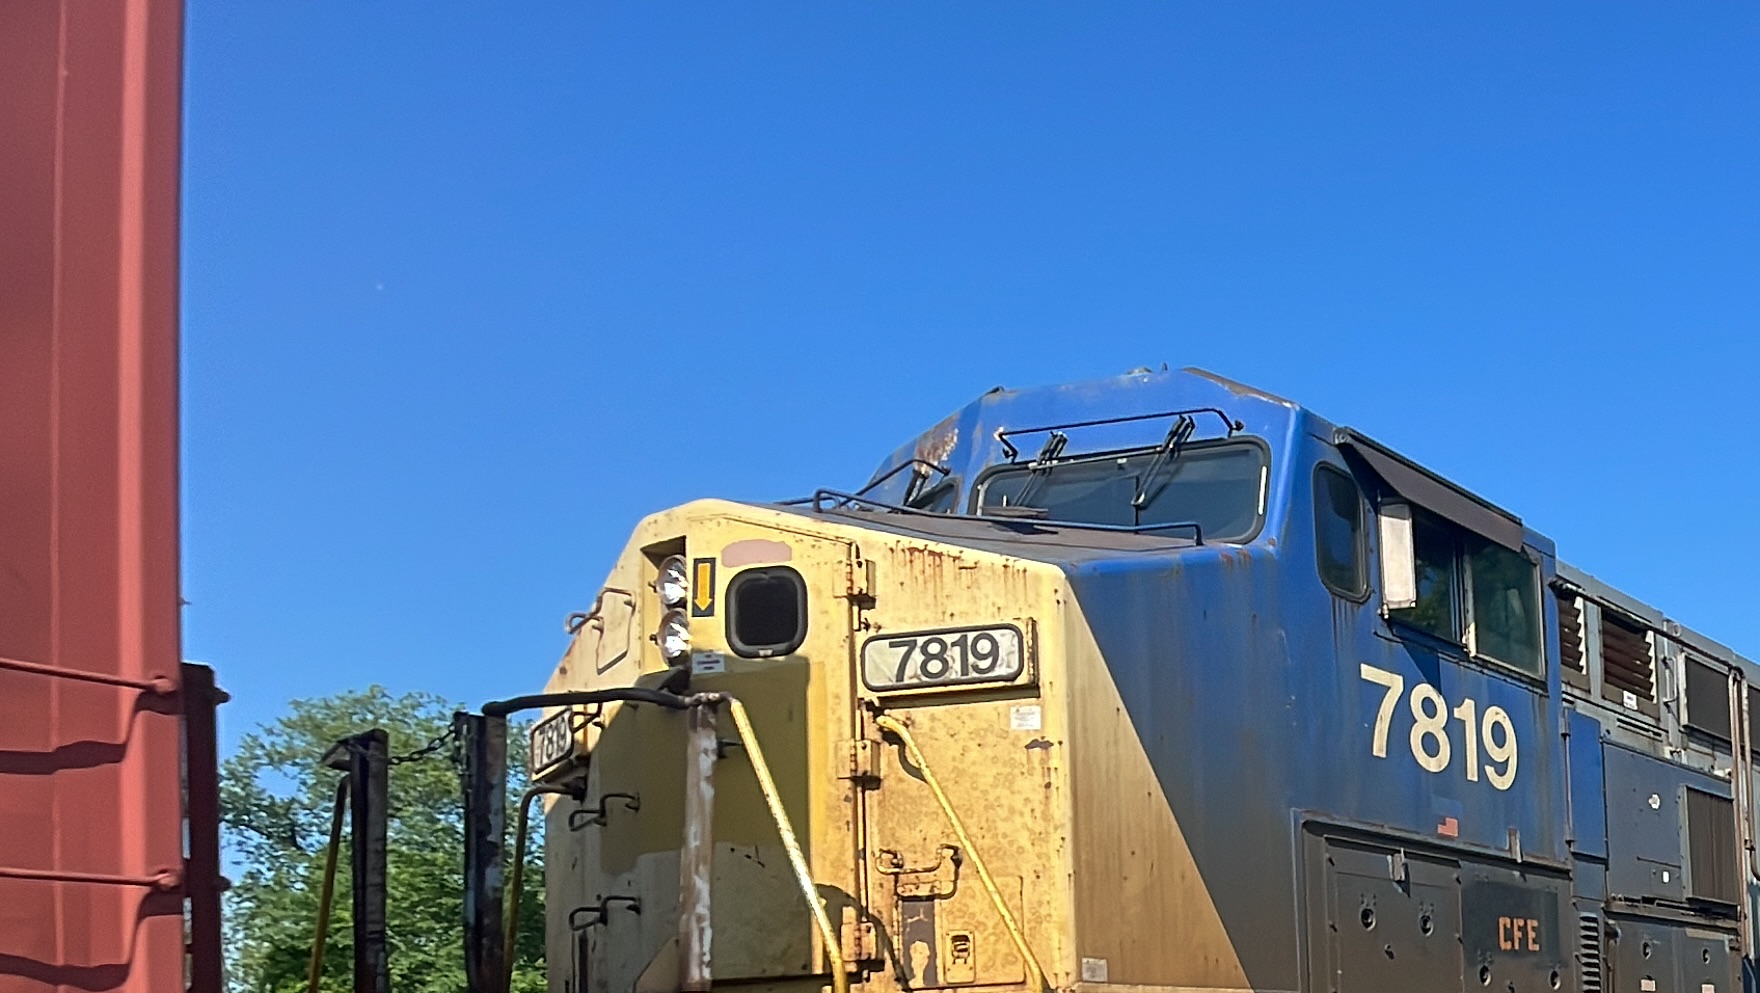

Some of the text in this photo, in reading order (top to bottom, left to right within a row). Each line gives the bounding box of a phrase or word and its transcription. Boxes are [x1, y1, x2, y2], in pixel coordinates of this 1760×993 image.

[888, 632, 1000, 683] 7819
[538, 715, 567, 763] 7819
[1360, 662, 1518, 791] 7819
[1498, 916, 1540, 951] CFE
